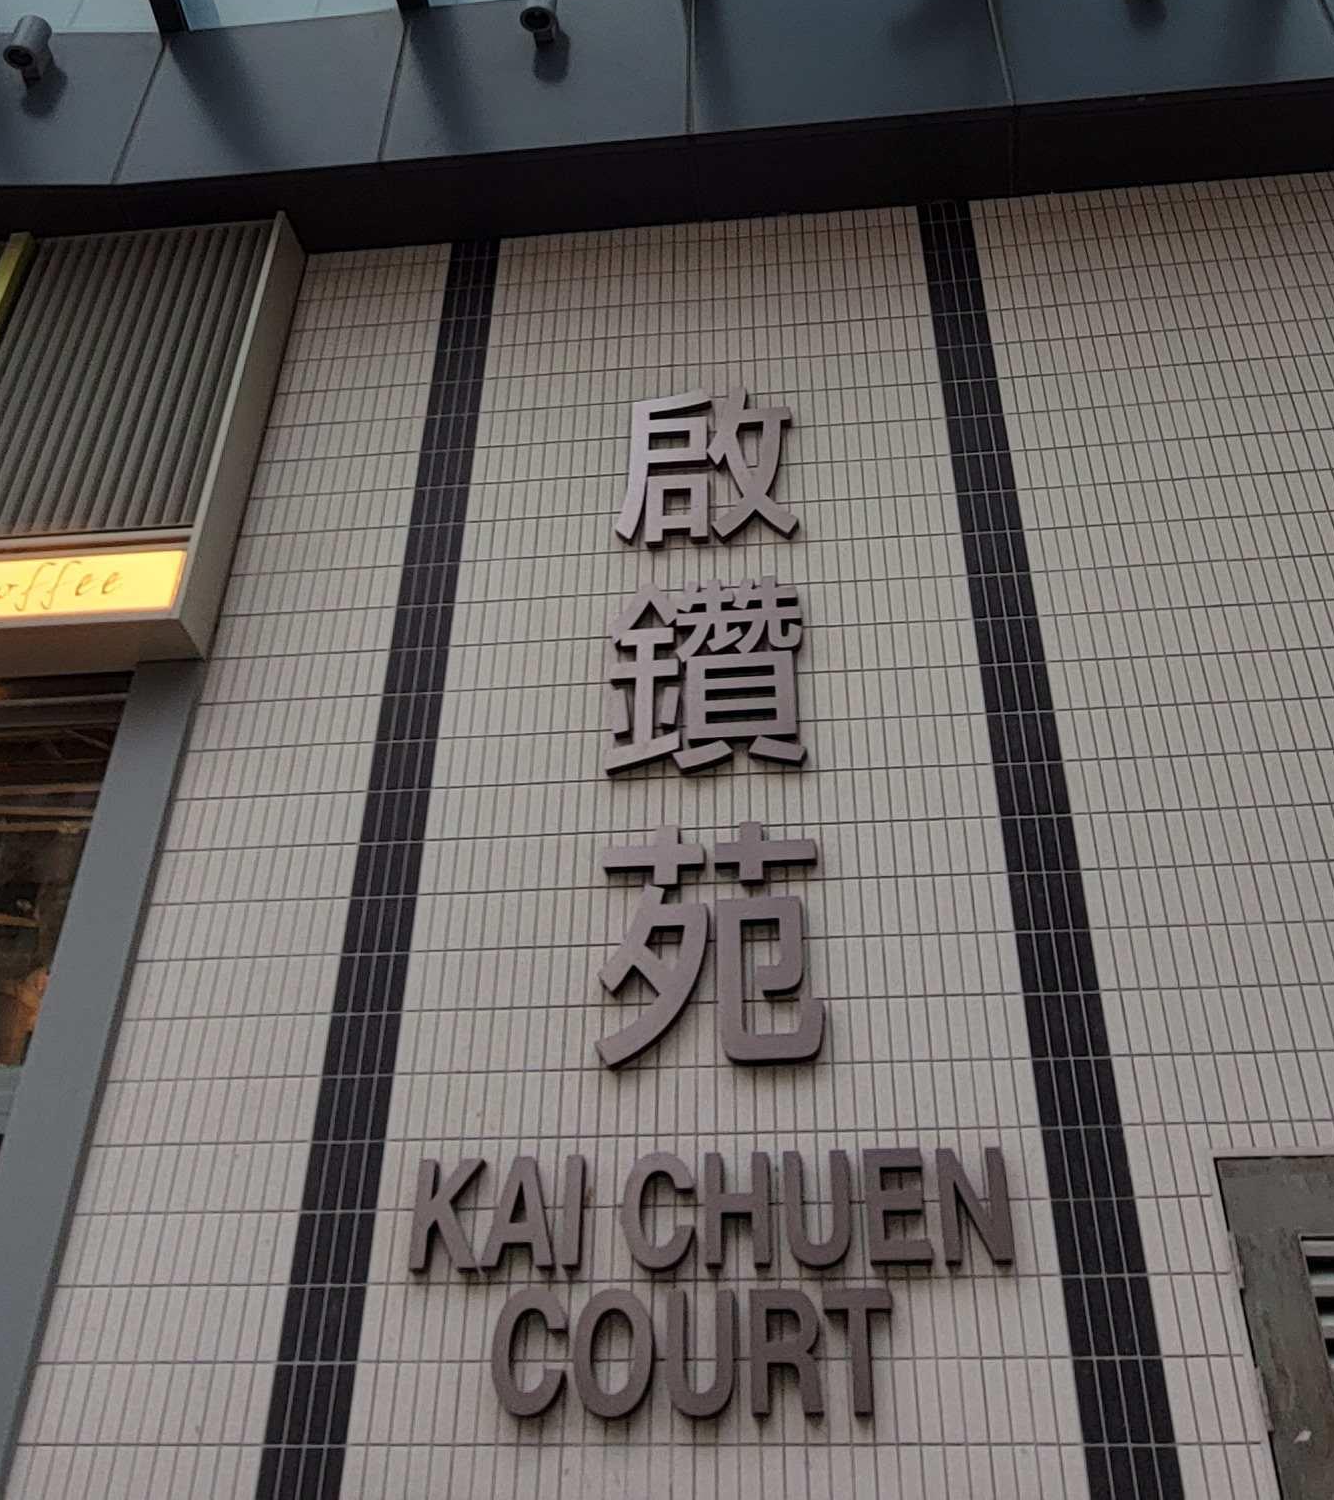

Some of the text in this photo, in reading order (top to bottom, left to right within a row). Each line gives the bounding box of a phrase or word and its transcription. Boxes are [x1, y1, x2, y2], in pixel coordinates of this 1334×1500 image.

[596, 386, 835, 1072] 啟鑽苑
[407, 1145, 1015, 1275] KAI CHUEN
[491, 1287, 893, 1421] COURT
